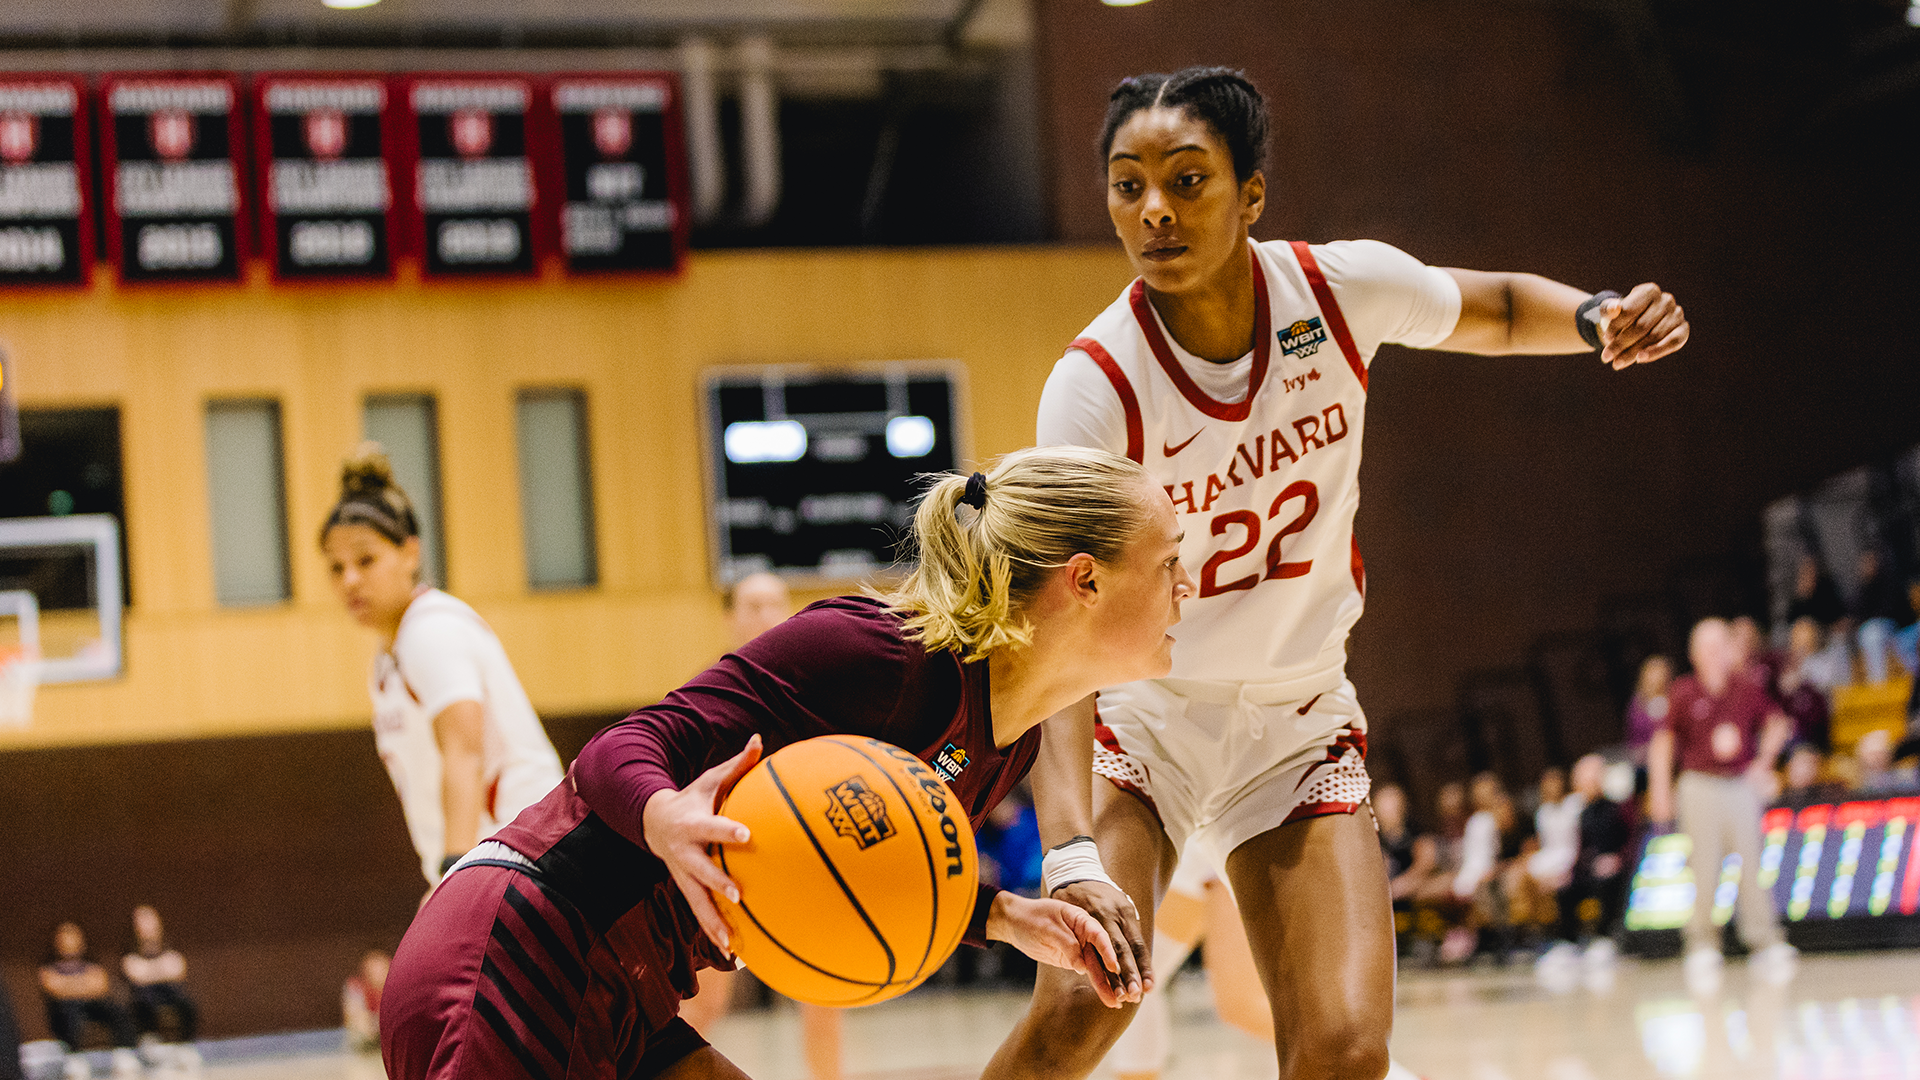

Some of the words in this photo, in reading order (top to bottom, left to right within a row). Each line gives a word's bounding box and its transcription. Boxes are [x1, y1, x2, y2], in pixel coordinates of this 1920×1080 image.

[1281, 327, 1323, 350] WBIT
[1283, 374, 1305, 393] Ivy
[1199, 480, 1319, 598] 22
[937, 751, 963, 777] WBIT
[836, 781, 882, 841] WBIT
